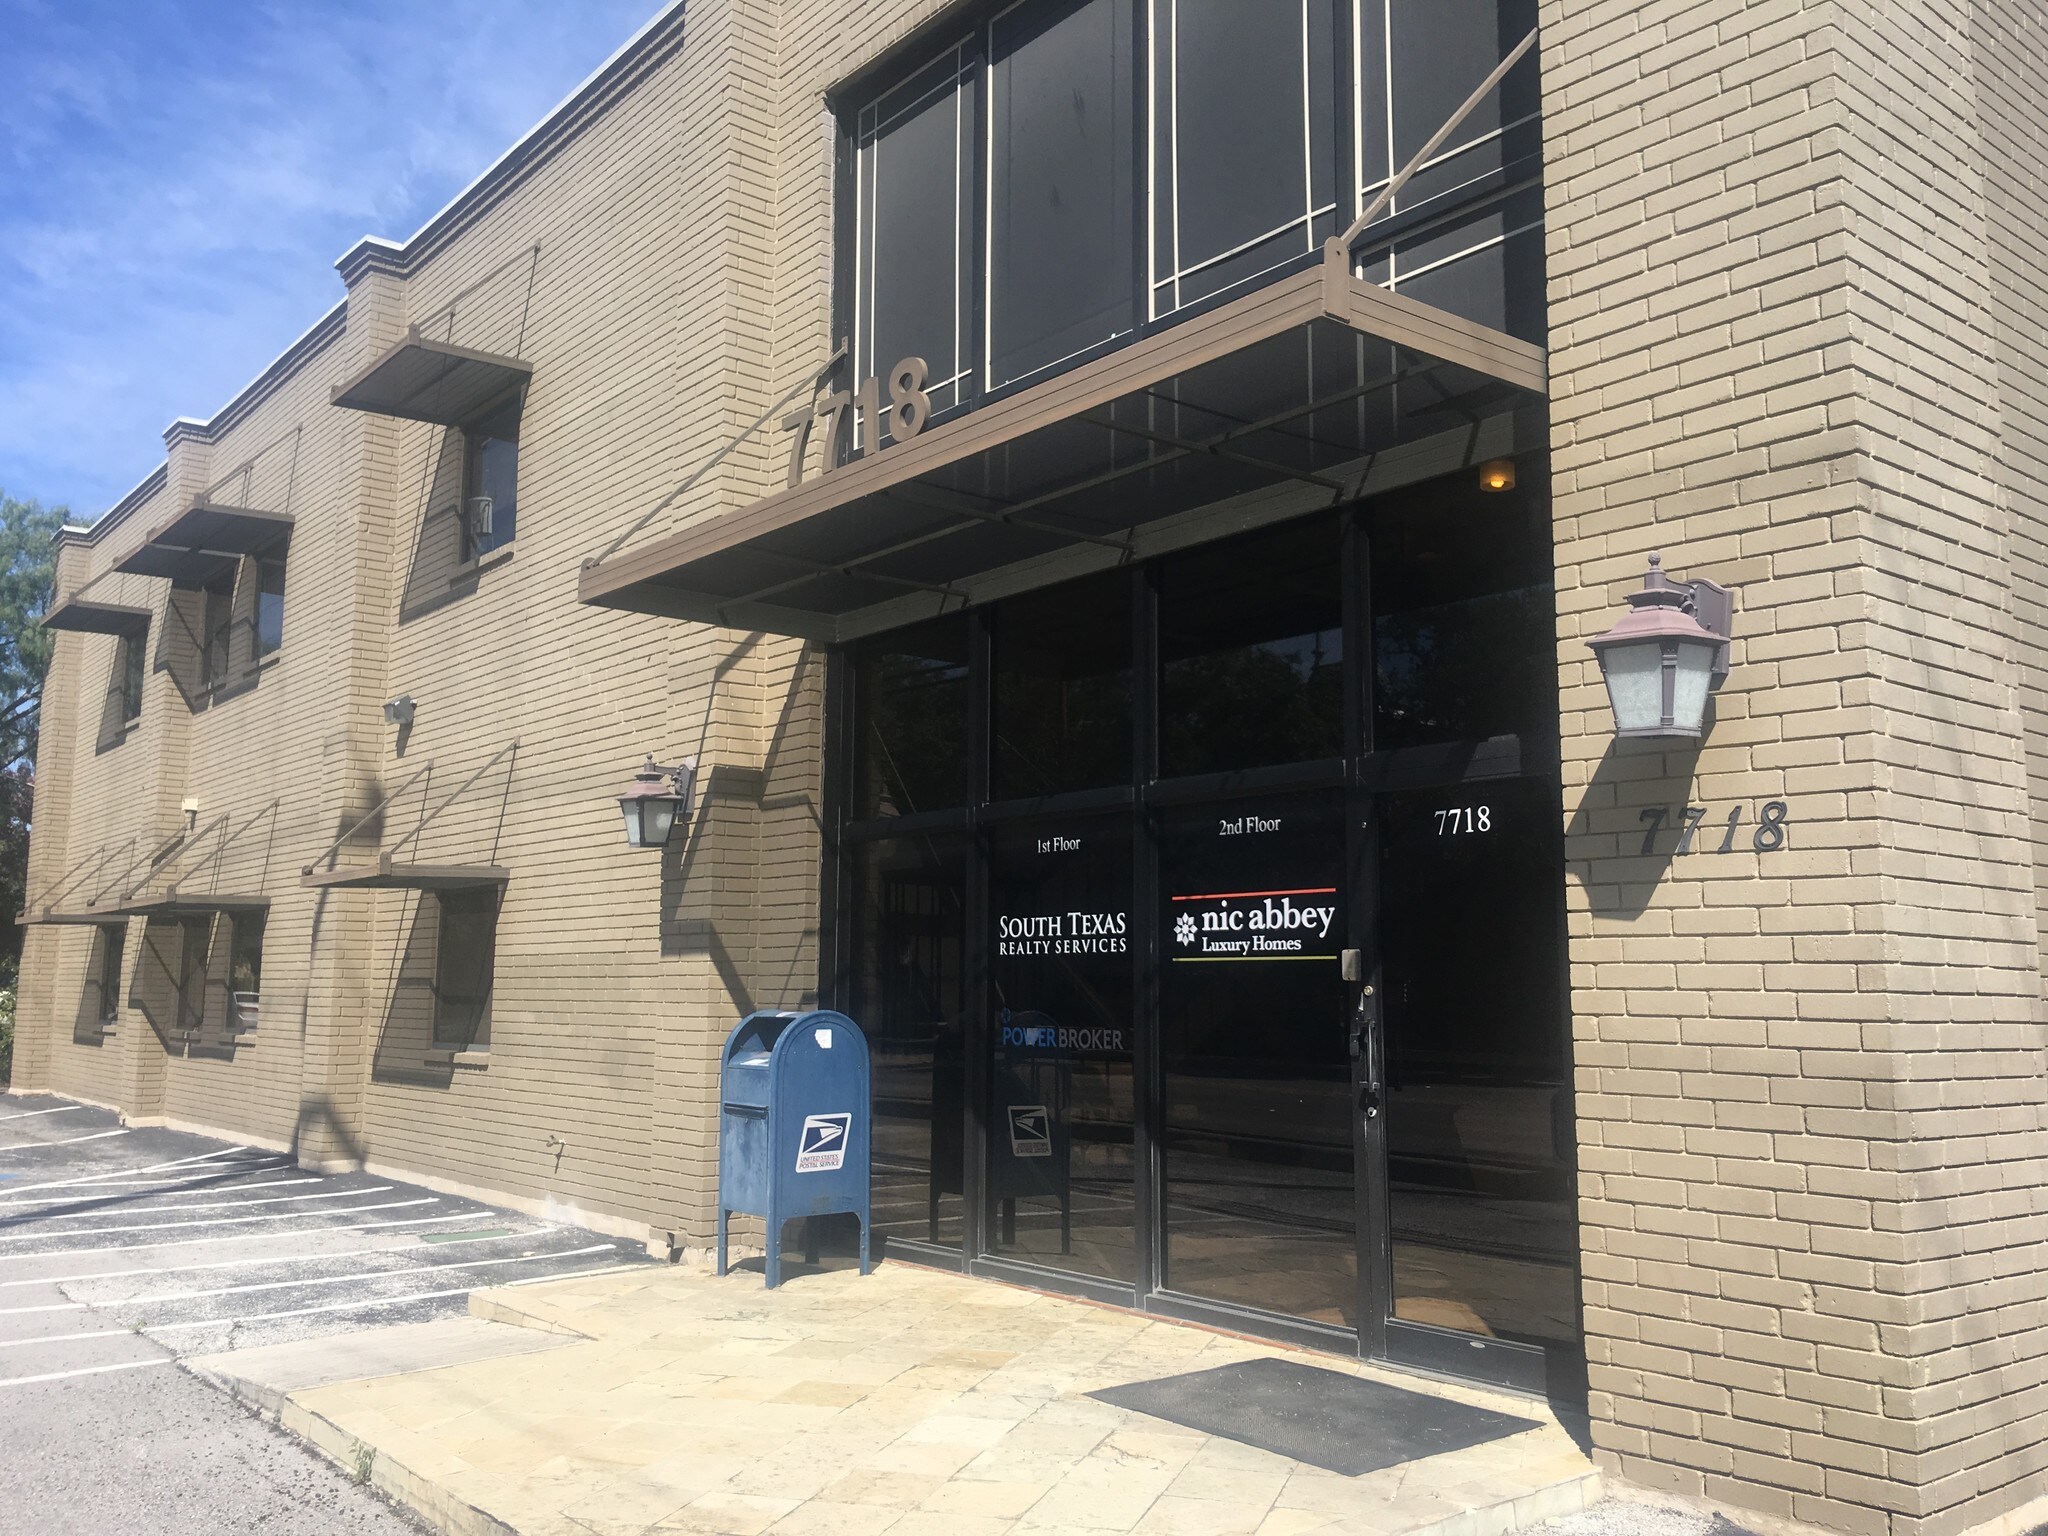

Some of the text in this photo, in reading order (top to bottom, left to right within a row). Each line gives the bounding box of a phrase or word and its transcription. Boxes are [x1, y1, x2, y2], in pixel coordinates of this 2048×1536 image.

[781, 357, 931, 489] 7718
[1218, 816, 1282, 836] 2nd Floor
[1433, 805, 1492, 836] 7718
[1639, 801, 1787, 855] 7718
[1037, 836, 1081, 853] 1st Floor
[999, 911, 1126, 938] SOUTH TEXAS
[1201, 897, 1336, 937] nic abbey
[999, 938, 1127, 955] REALTY SERVICES
[1201, 935, 1302, 955] Luxury Homes
